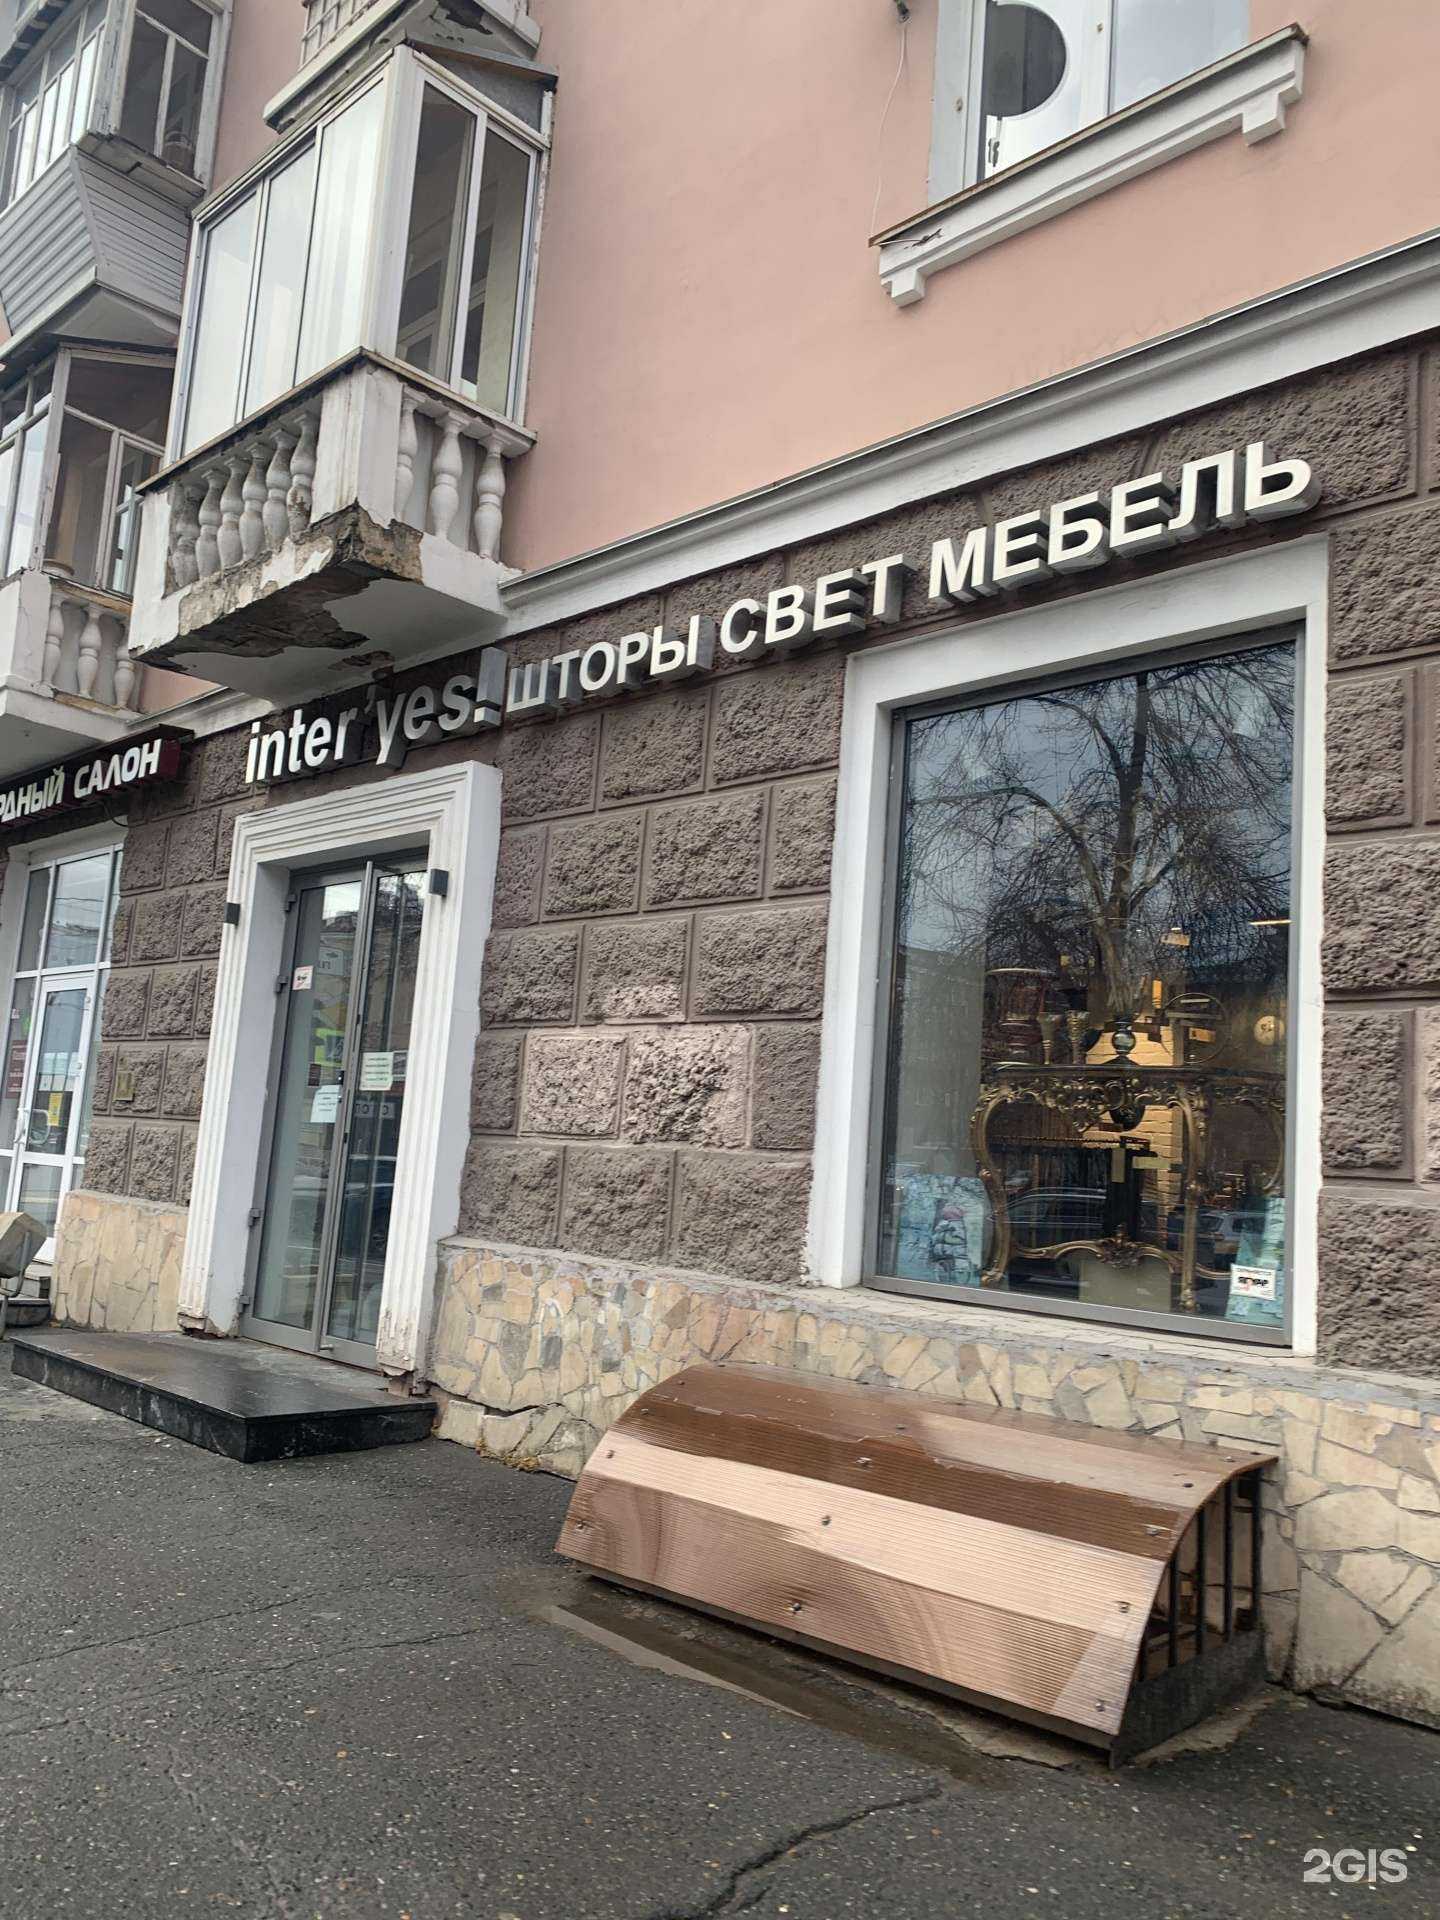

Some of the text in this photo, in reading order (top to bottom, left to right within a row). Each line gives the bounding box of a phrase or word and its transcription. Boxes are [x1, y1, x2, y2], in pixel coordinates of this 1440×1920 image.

[506, 441, 1313, 712] ШТОРЫ СВЕТ МЕБЕЛЬ
[74, 739, 162, 799] САЛОН
